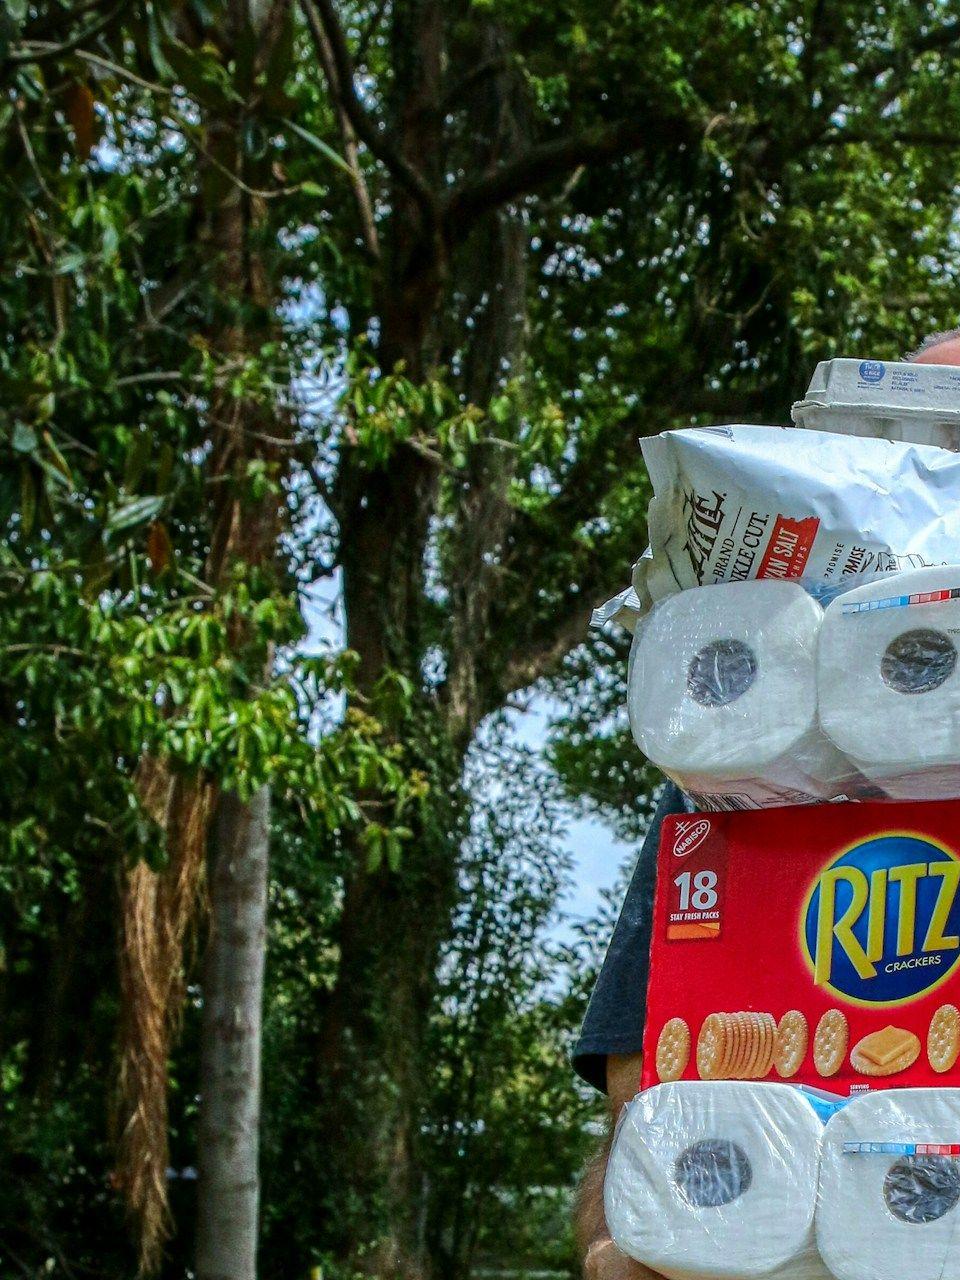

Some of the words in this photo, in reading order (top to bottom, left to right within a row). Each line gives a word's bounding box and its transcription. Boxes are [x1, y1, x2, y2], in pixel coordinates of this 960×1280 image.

[773, 528, 799, 557] SALT
[713, 538, 735, 578] BRAND
[676, 823, 708, 853] NABISCO
[674, 871, 718, 911] 18
[885, 955, 941, 973] CRACKERS
